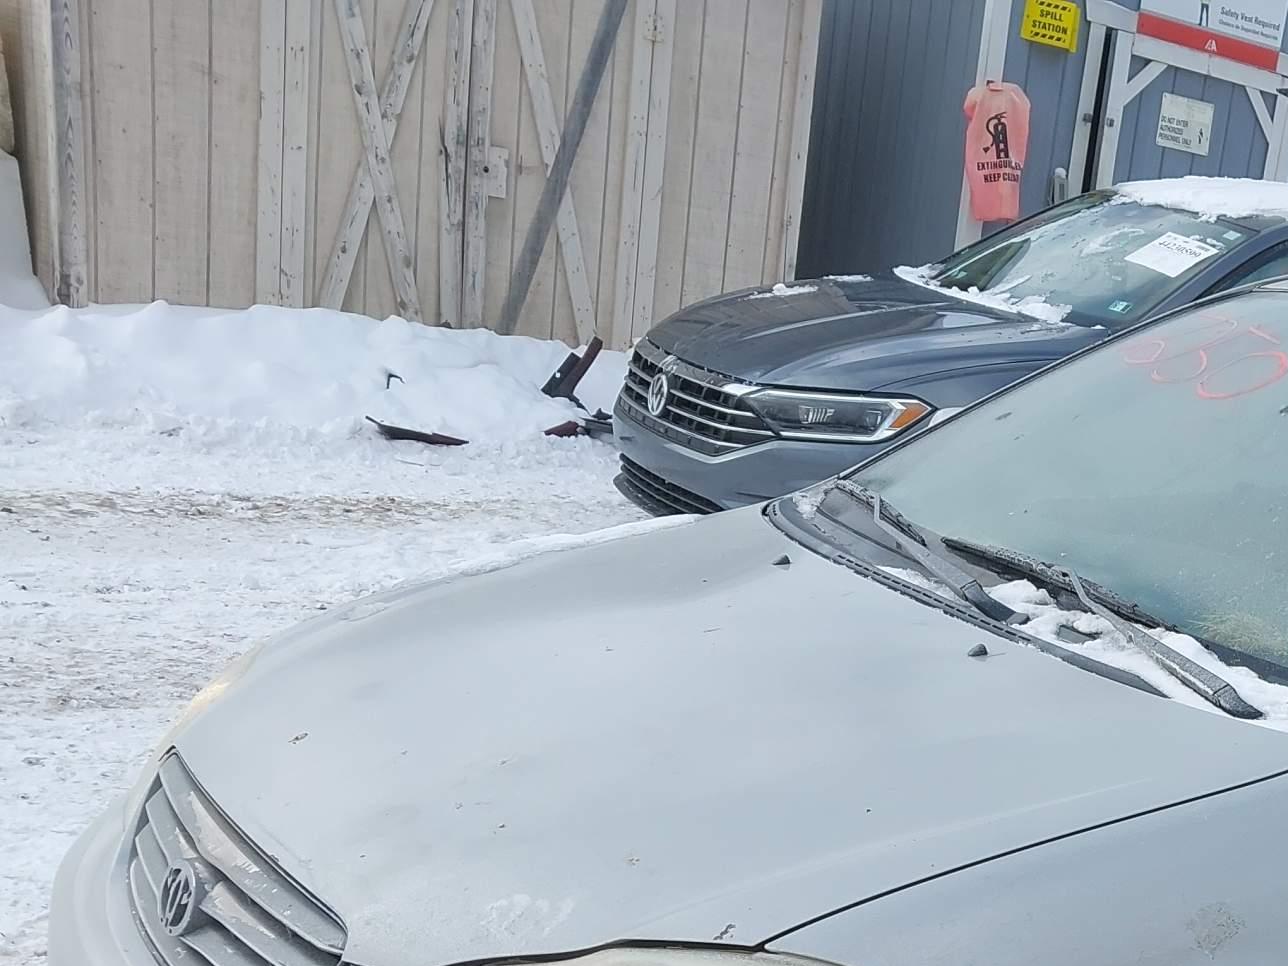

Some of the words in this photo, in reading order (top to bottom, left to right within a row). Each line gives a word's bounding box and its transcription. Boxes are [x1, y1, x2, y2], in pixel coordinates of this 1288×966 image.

[1040, 9, 1063, 22] SPILL
[1220, 6, 1239, 20] Safety
[1254, 17, 1280, 31] Required
[1031, 19, 1068, 36] STATION
[983, 172, 1002, 184] KEEP
